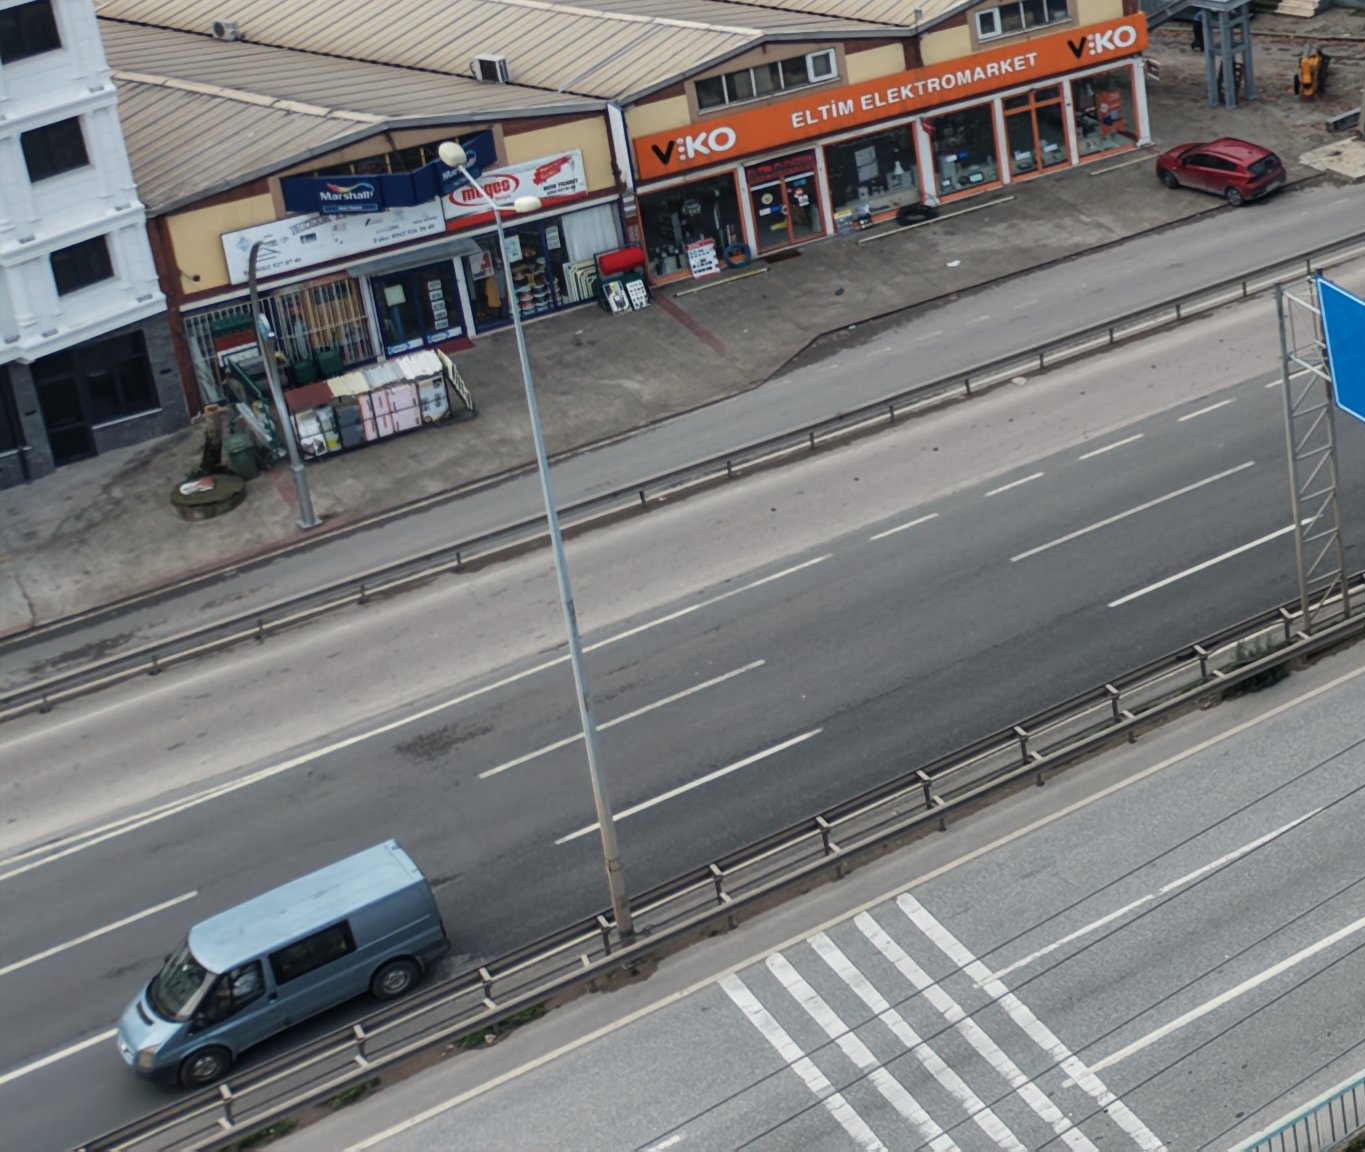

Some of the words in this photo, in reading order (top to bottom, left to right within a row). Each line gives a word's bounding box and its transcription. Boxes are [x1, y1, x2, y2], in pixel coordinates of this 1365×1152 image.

[791, 98, 854, 129] ELTİM
[861, 52, 1038, 111] ELEKTROMARKET
[320, 191, 374, 202] Marshall
